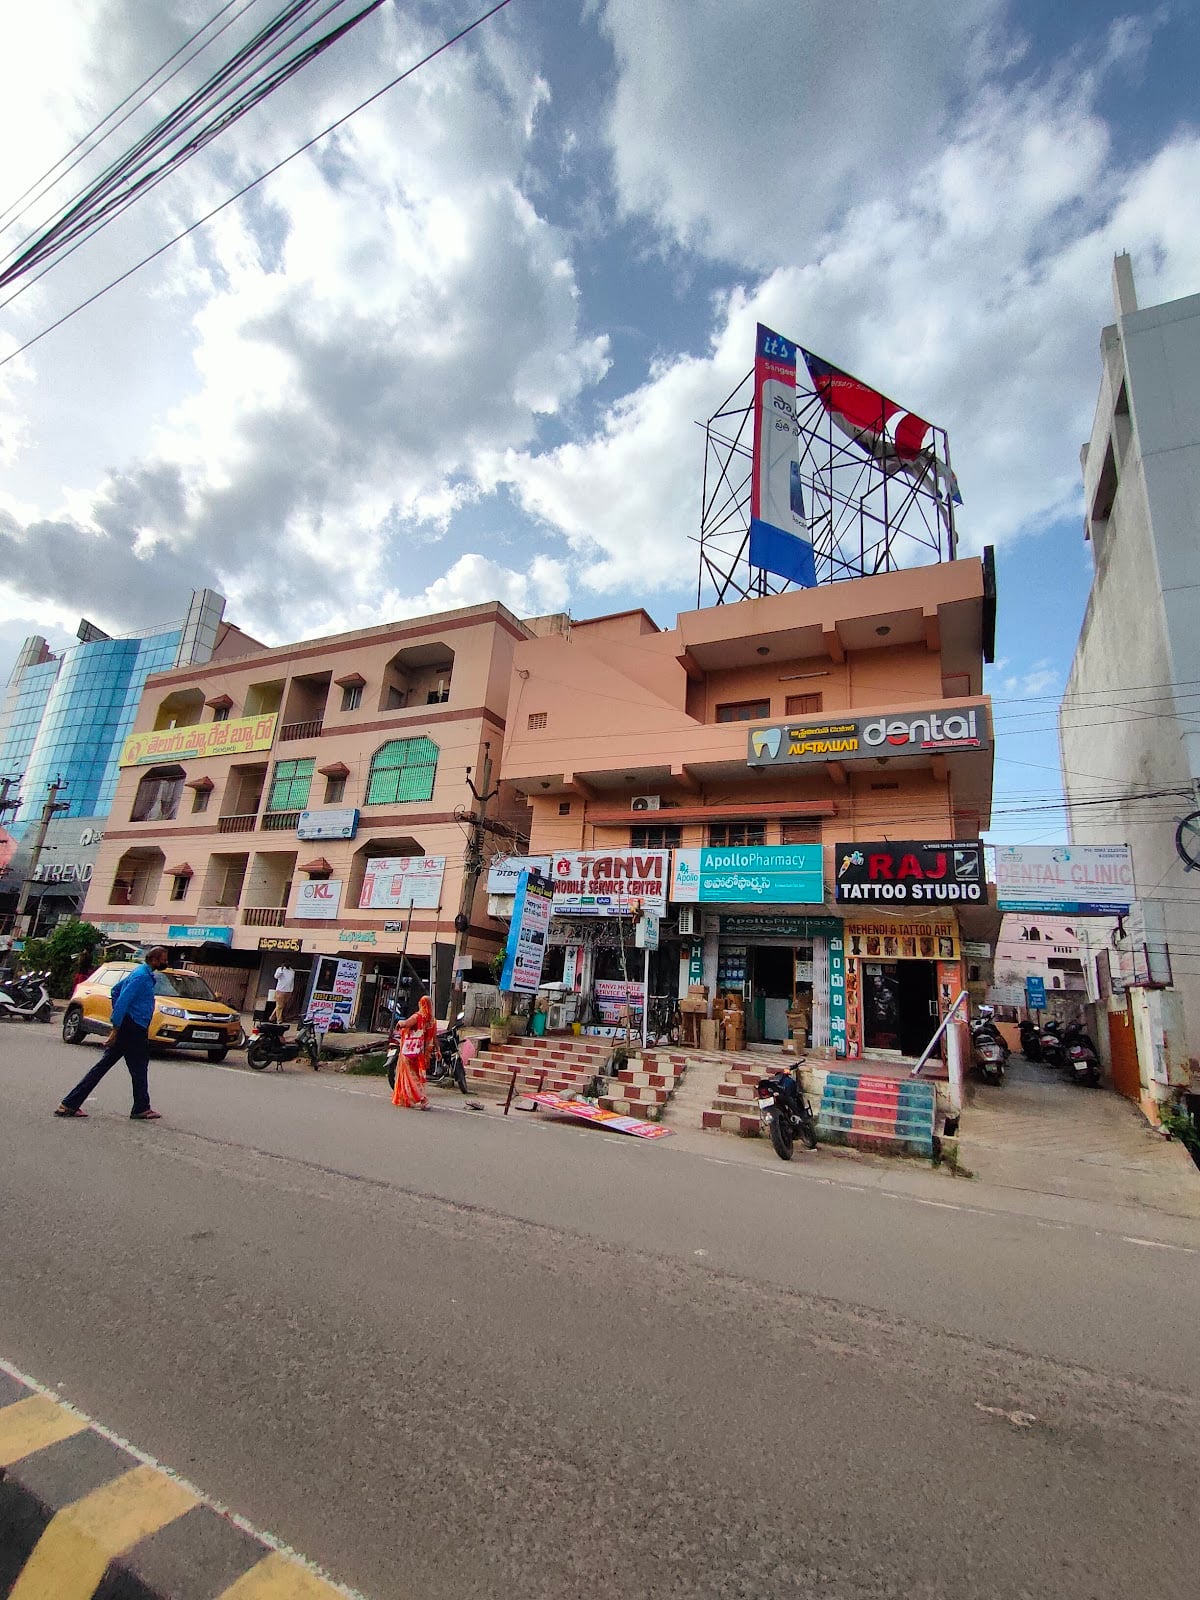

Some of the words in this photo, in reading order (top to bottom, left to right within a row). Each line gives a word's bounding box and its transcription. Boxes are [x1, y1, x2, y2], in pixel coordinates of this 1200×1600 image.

[764, 336, 789, 358] it's
[863, 710, 977, 746] dental
[147, 731, 185, 754] తెలుగు
[787, 738, 858, 755] AUSTRALIAN
[576, 856, 663, 880] TANVI
[705, 852, 805, 870] ApolloPharmacy
[868, 852, 947, 880] RAJ
[676, 872, 699, 885] Apollo
[998, 863, 1066, 885] DENTAL
[1070, 863, 1132, 885] CLINIC
[314, 884, 334, 898] KL
[553, 880, 585, 895] MOBILE
[588, 880, 624, 895] SERVICE
[627, 880, 662, 896] CENTER
[841, 883, 906, 899] TATTOO
[912, 883, 981, 900] STUDIO
[848, 924, 889, 935] MEHENDI
[899, 924, 932, 936] TATTOO
[935, 925, 952, 936] ART
